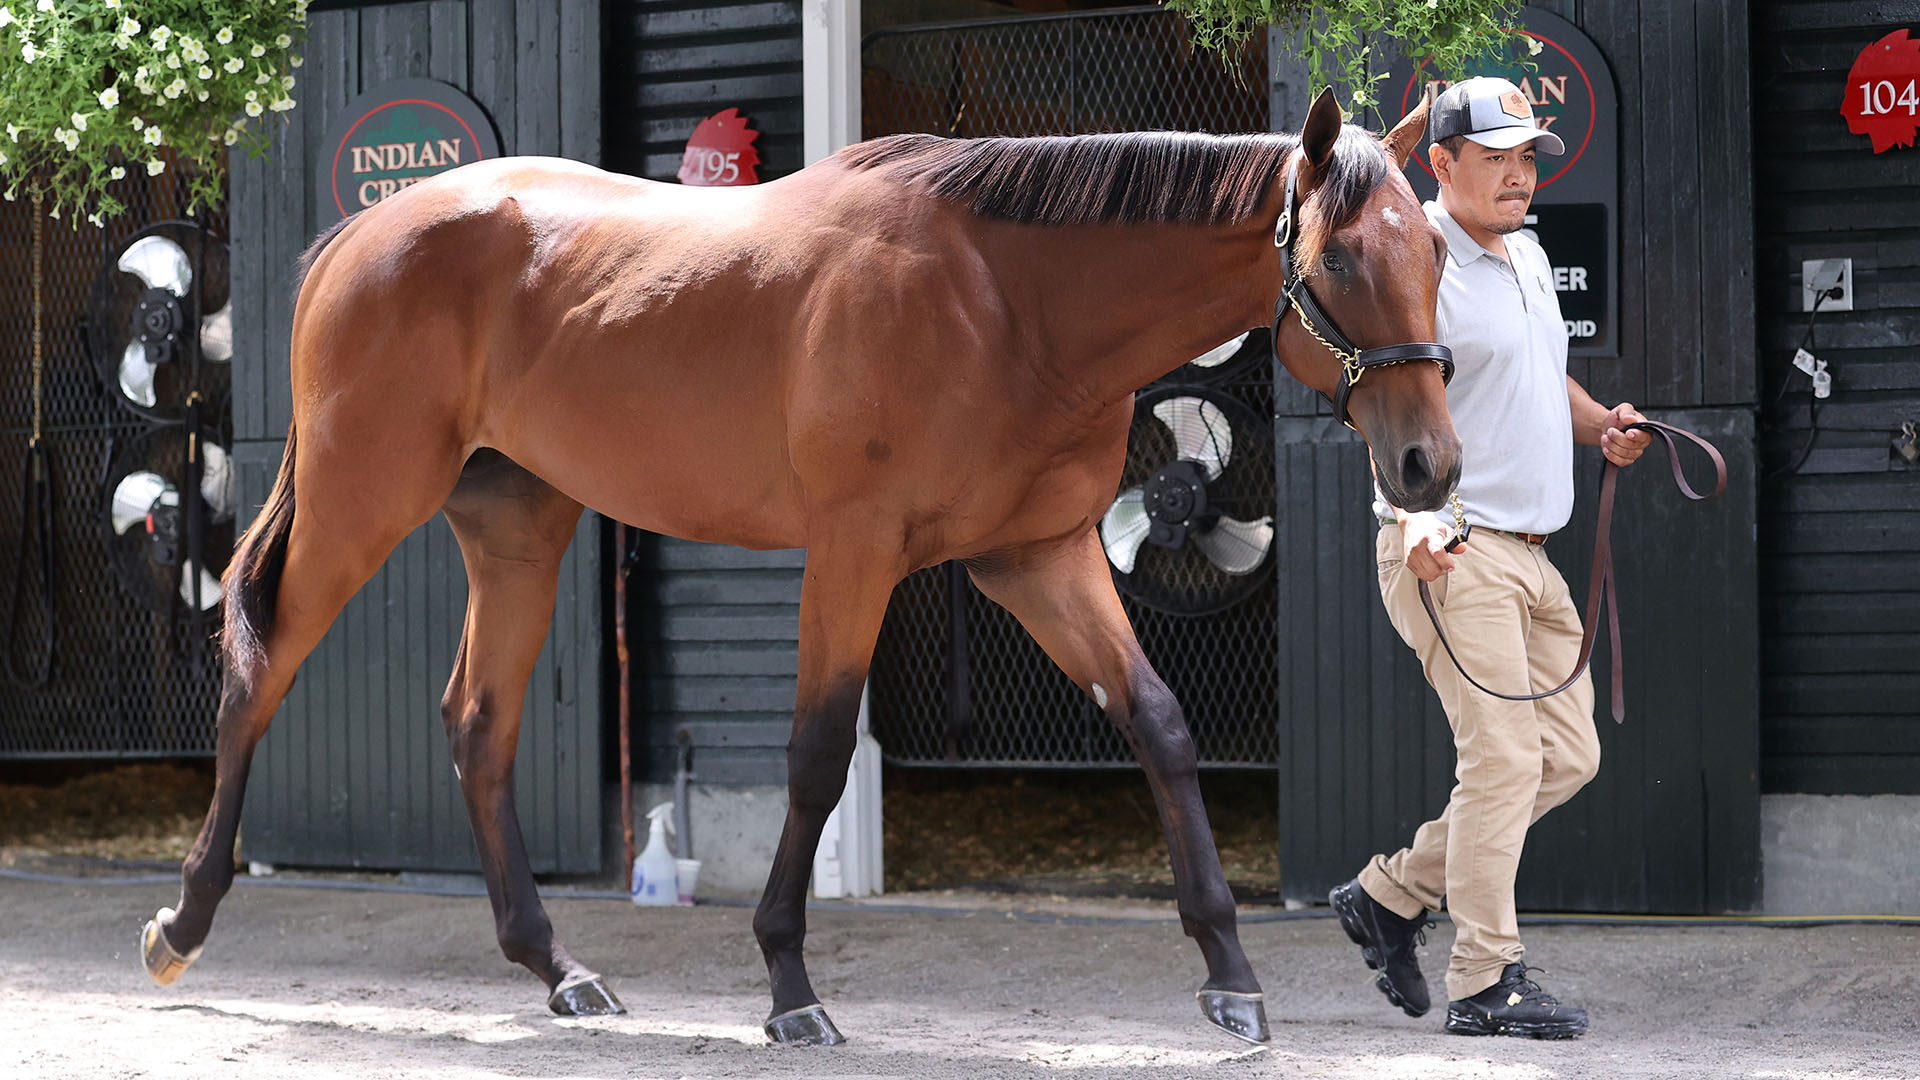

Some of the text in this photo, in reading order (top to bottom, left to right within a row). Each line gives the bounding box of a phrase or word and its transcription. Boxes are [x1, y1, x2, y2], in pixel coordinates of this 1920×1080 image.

[1859, 79, 1920, 116] 104
[351, 138, 462, 174] INDIAN
[697, 151, 740, 183] 195
